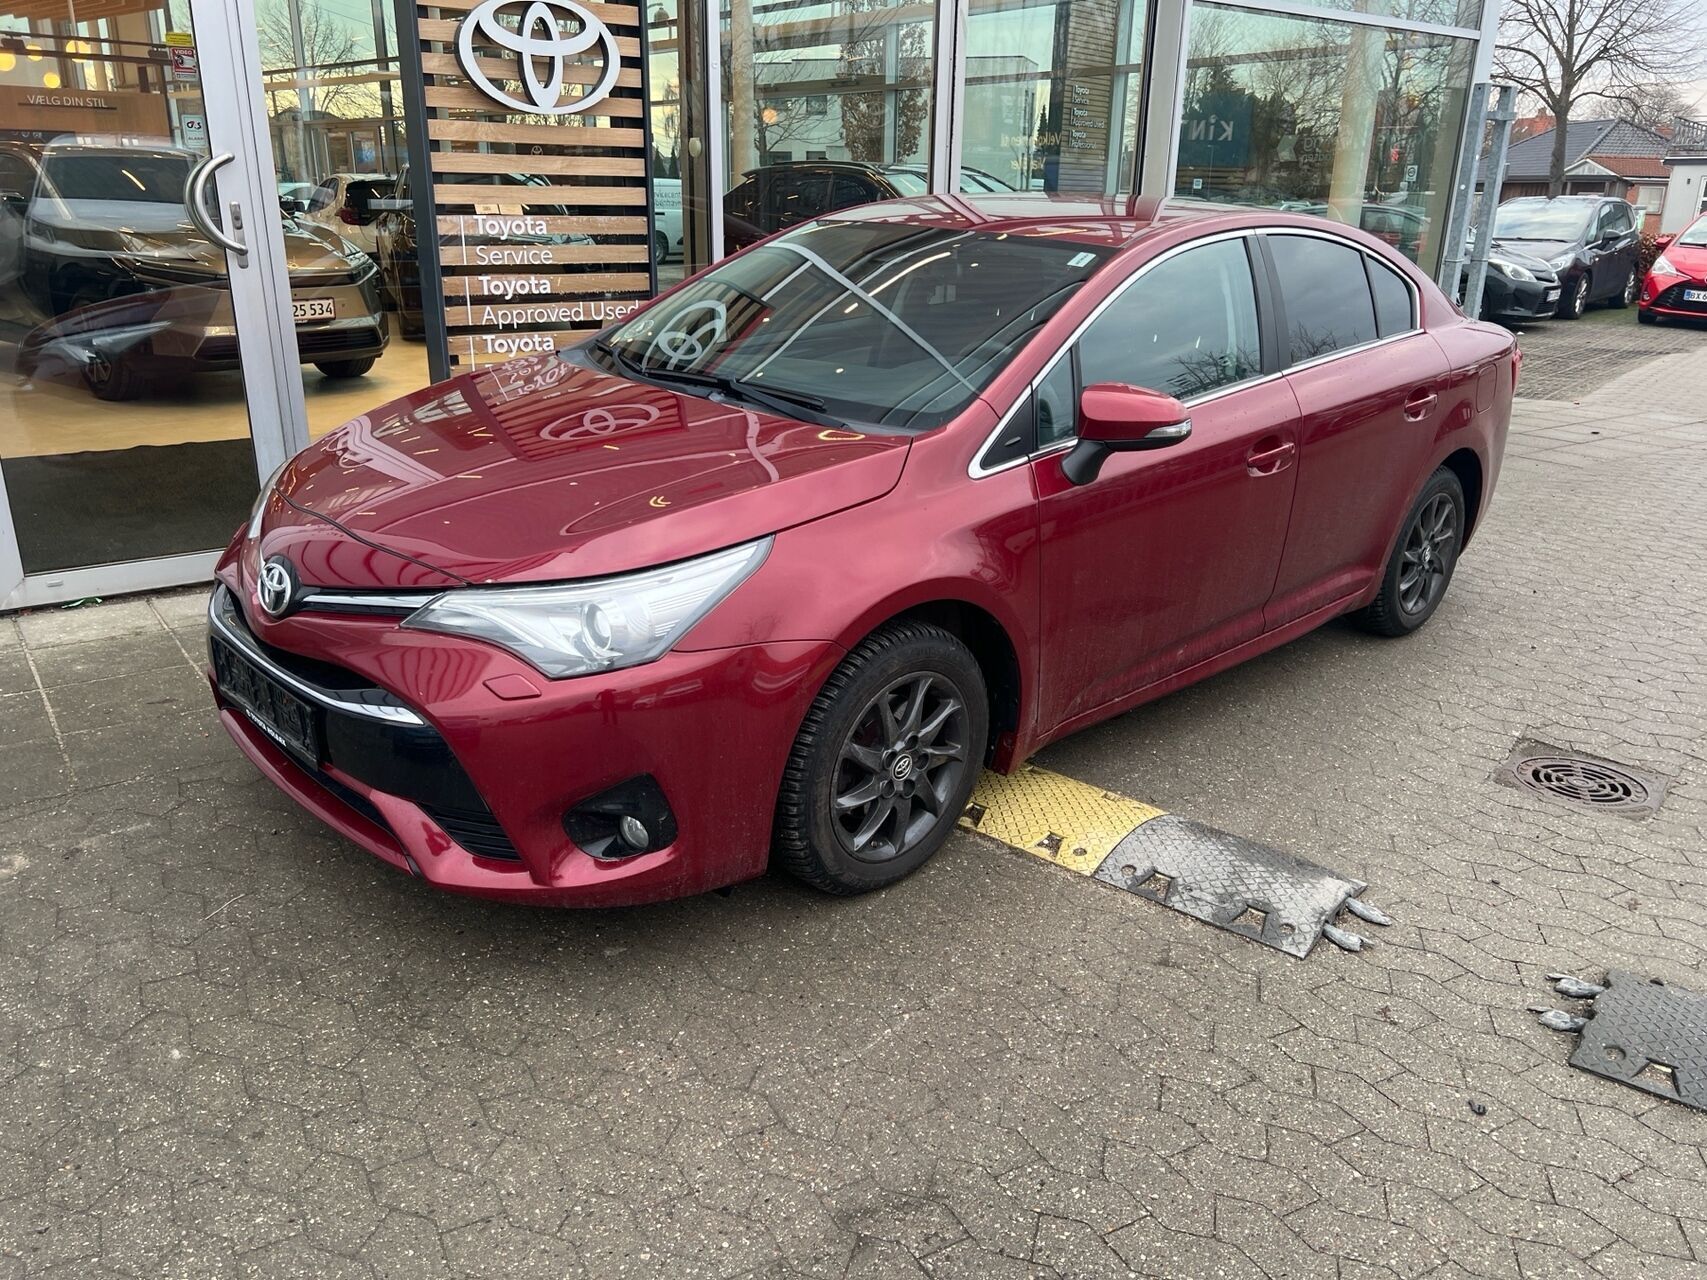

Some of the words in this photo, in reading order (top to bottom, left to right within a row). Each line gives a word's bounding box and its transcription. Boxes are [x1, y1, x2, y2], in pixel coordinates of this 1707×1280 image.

[1075, 85, 1089, 95] Toyota
[26, 95, 60, 106] VÆLG
[63, 97, 84, 107] DIN
[86, 97, 107, 108] STIL
[1073, 107, 1088, 118] Toyota
[1072, 130, 1087, 139] Toyota
[473, 215, 547, 240] Toyota
[476, 246, 553, 265] Service
[478, 276, 551, 300] Toyota
[292, 304, 306, 317] 25
[310, 303, 332, 316] 534
[482, 302, 583, 329] Approved
[591, 301, 639, 321] Used
[483, 334, 554, 357] Toyota
